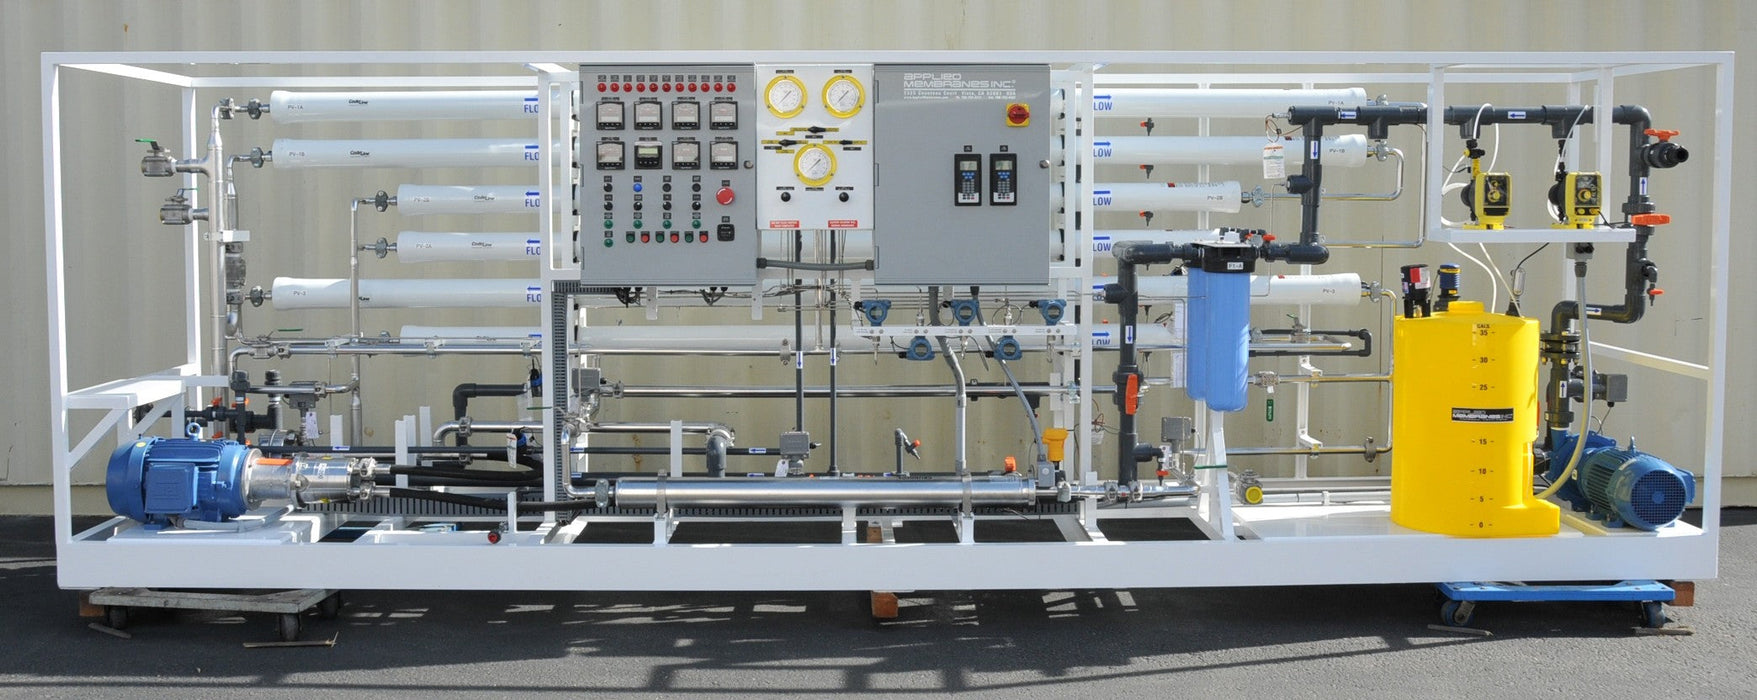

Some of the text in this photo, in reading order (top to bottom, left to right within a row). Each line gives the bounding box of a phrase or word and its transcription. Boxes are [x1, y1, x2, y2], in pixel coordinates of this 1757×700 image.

[524, 104, 538, 113] FLO
[1093, 102, 1112, 110] LOW
[525, 152, 539, 160] FLO
[1093, 148, 1112, 157] LOW
[525, 199, 540, 207] FLO
[1093, 197, 1112, 206] LOW
[526, 247, 541, 255] FLO
[1092, 243, 1111, 252] LOW
[527, 294, 541, 302] FLO
